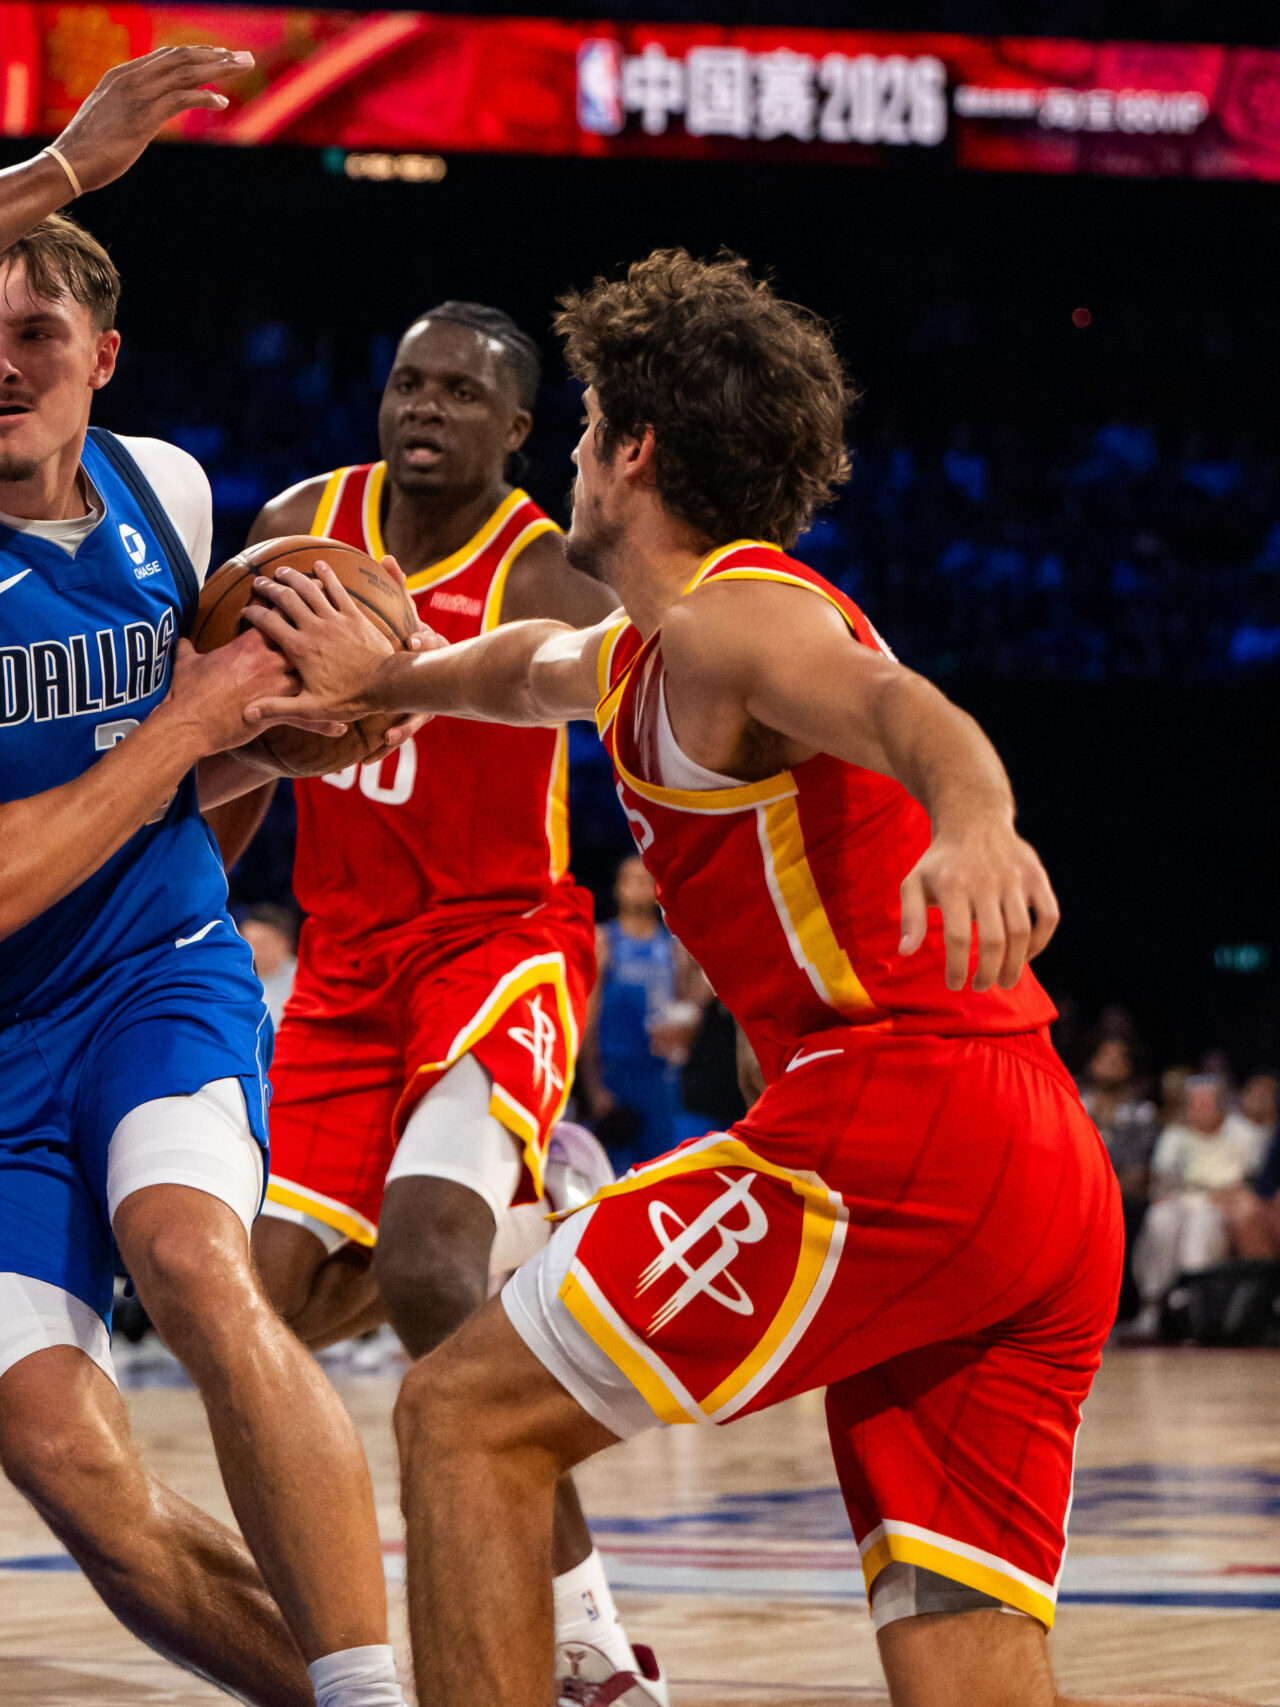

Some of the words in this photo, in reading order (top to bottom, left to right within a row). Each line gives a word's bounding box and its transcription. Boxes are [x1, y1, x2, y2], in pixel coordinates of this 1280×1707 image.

[622, 41, 947, 146] 中国赛2026
[134, 560, 162, 580] CHASE
